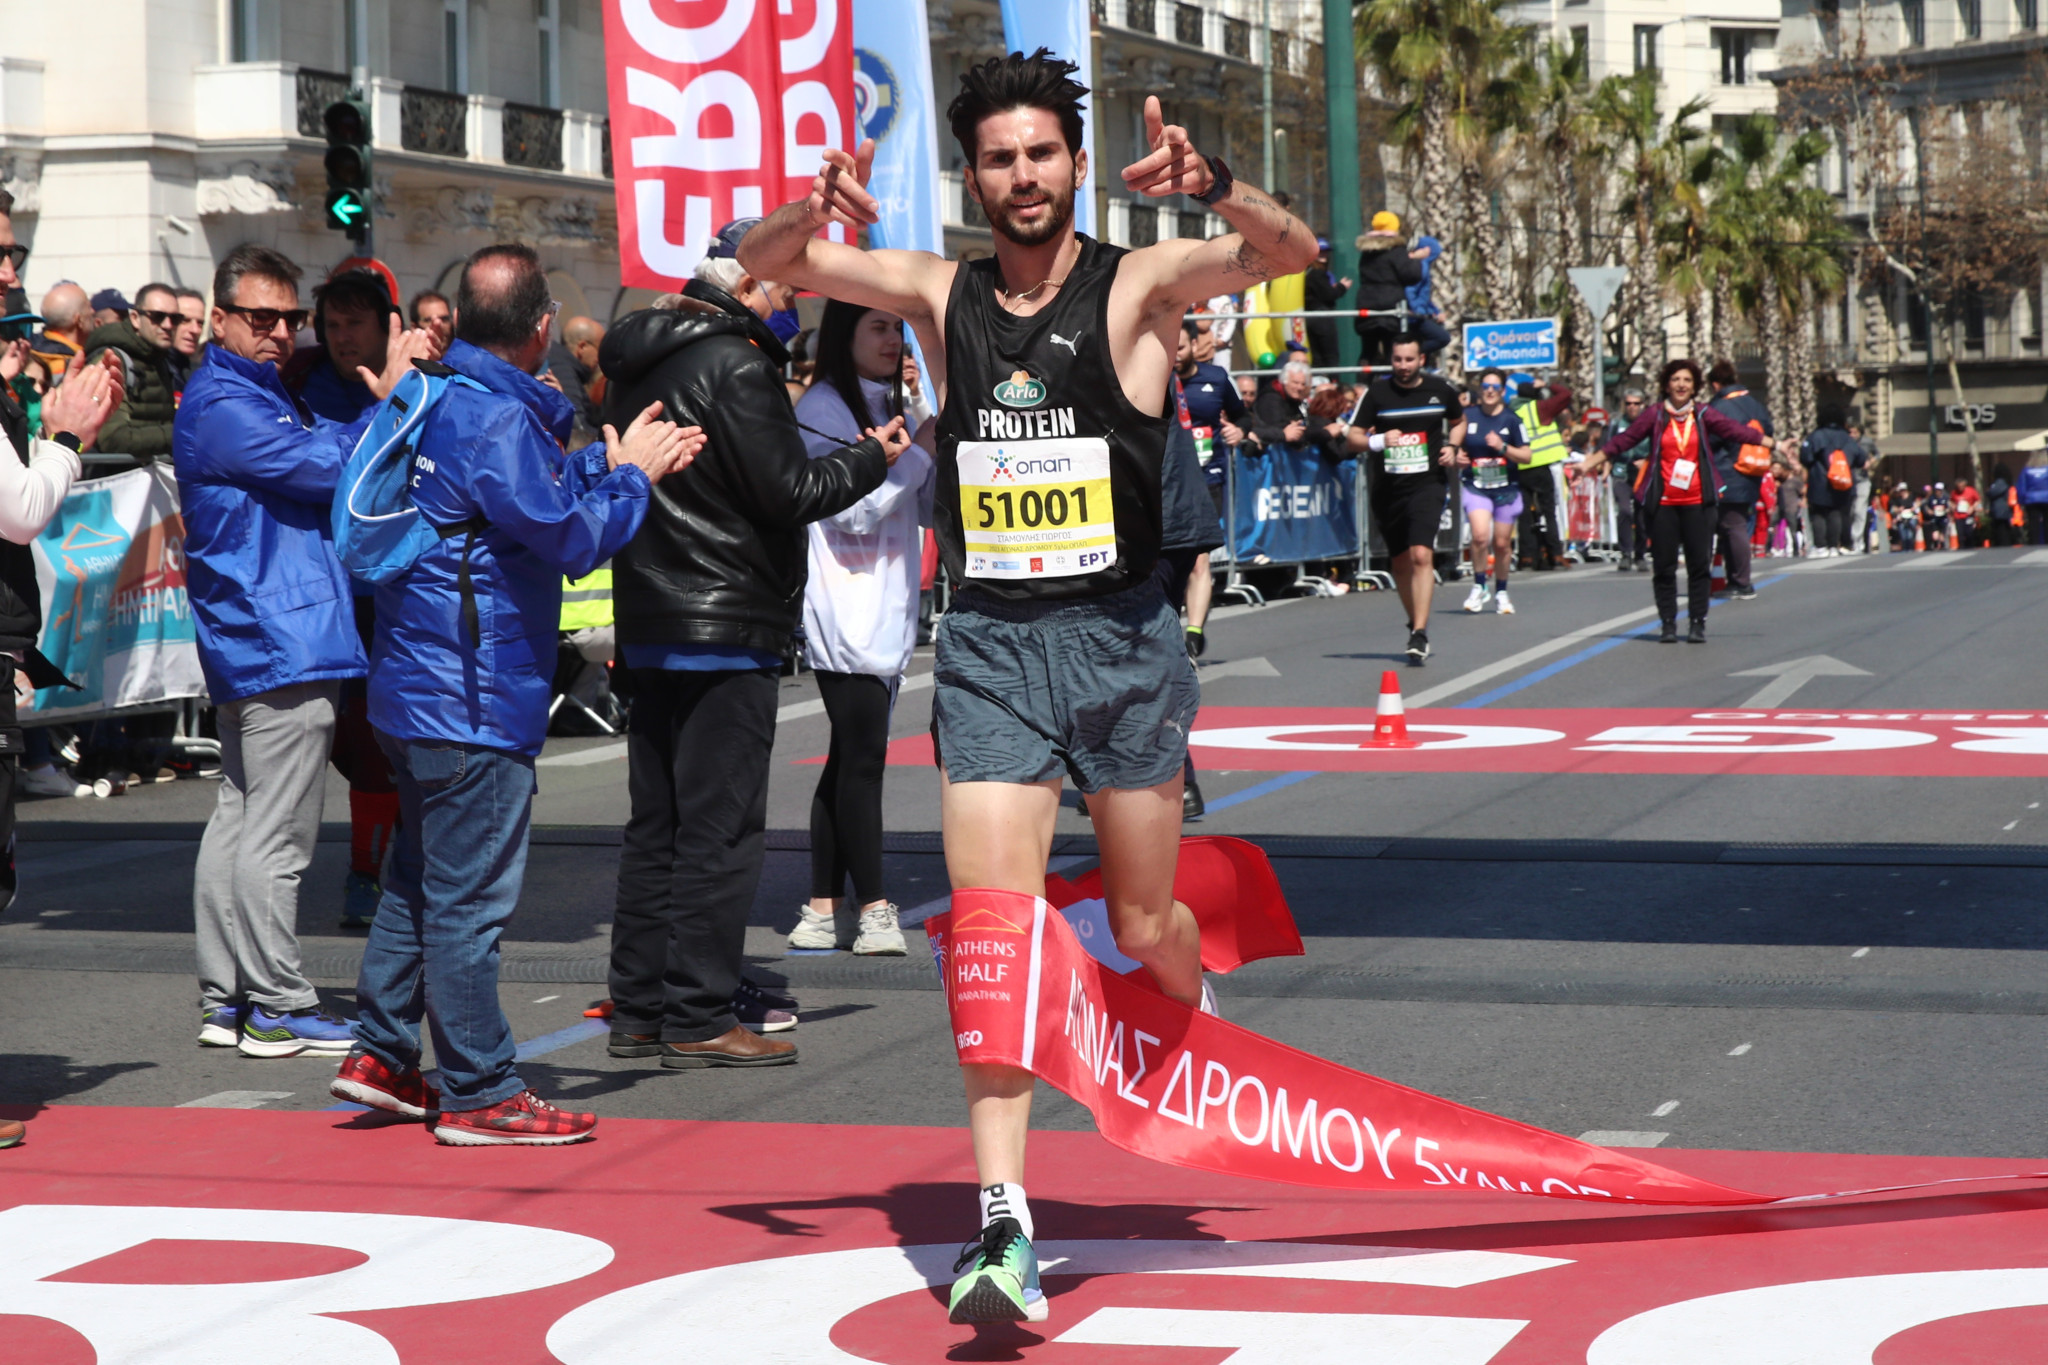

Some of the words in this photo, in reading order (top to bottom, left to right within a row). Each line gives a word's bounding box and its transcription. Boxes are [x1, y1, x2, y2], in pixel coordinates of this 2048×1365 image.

[1488, 329, 1549, 346] Ομόνοι
[1488, 345, 1550, 361] Omonoia
[1003, 384, 1038, 399] Arla
[978, 407, 1076, 439] PROTEIN
[1389, 445, 1424, 459] 10516
[978, 486, 1088, 528] 51001
[997, 533, 1040, 543] ΣΤΑΜΟΥΛΗΣ
[1042, 531, 1072, 541] ΓΙΩΡΓΟΣ
[955, 940, 1017, 958] ATHENS
[958, 962, 1010, 984] HALF
[957, 989, 1011, 1002] MARATHON
[957, 1029, 983, 1049] ERGO
[1157, 1049, 1401, 1180] ΔΡΟΜΟΥ
[983, 1183, 1012, 1226] PU
